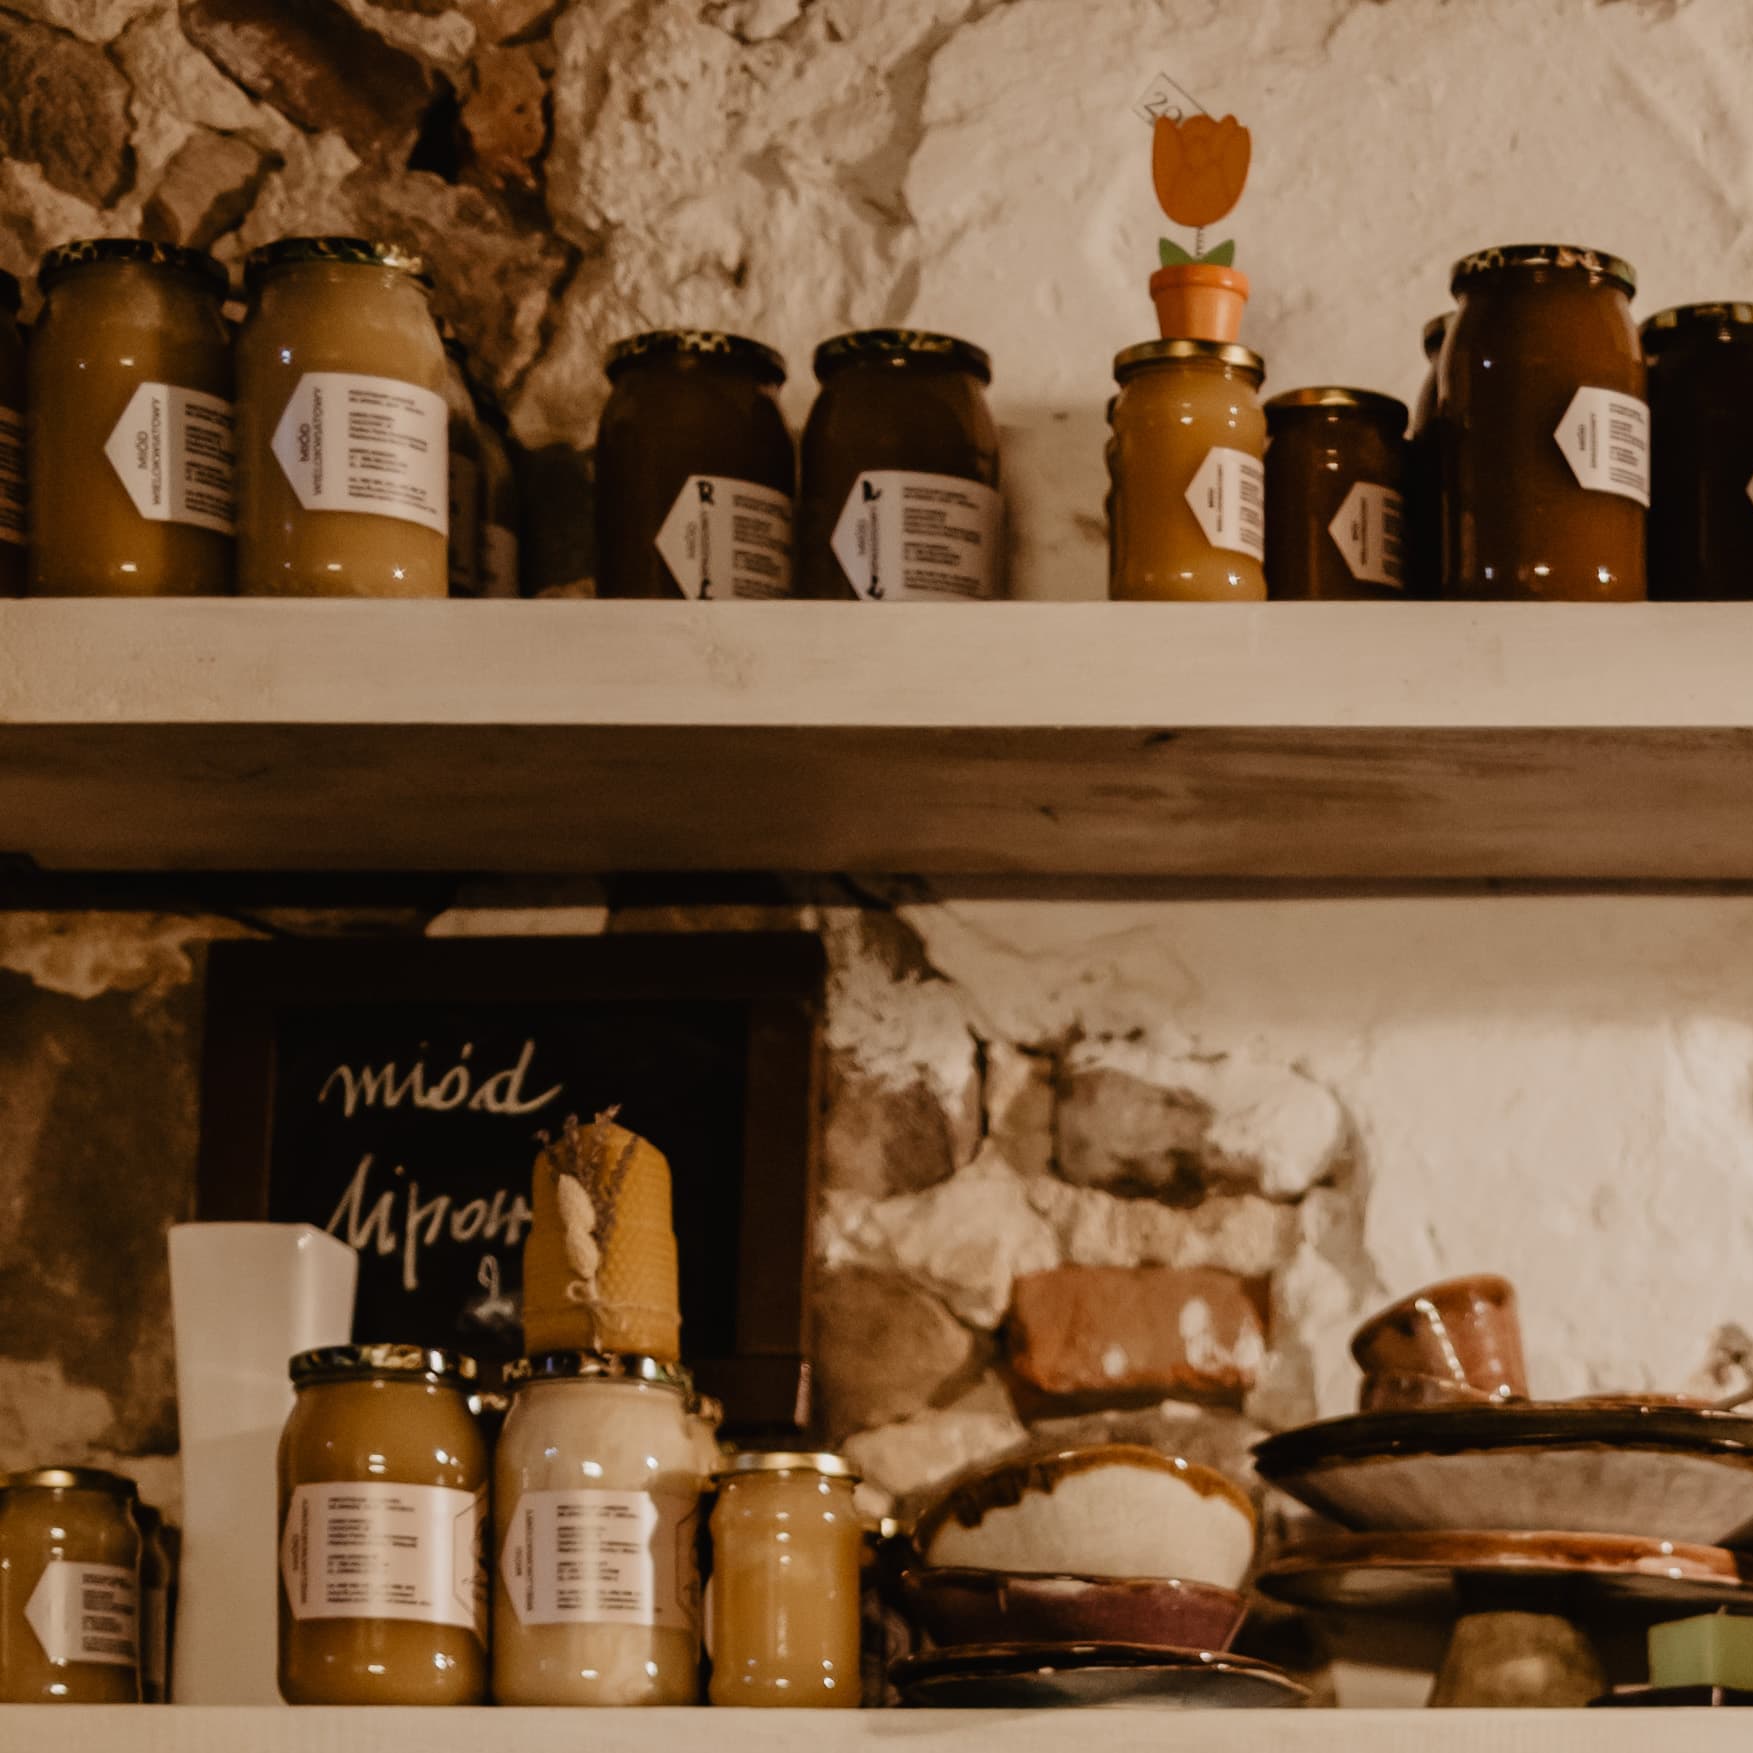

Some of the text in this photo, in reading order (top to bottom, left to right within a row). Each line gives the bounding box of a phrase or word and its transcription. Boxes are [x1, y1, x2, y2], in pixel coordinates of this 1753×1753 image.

[135, 430, 149, 470] MIÓD
[151, 397, 162, 505] WIELOKWIATOWY
[297, 423, 311, 463] MIÓD
[311, 387, 323, 496] WIELOKWIATOWY
[319, 1038, 563, 1117] miód
